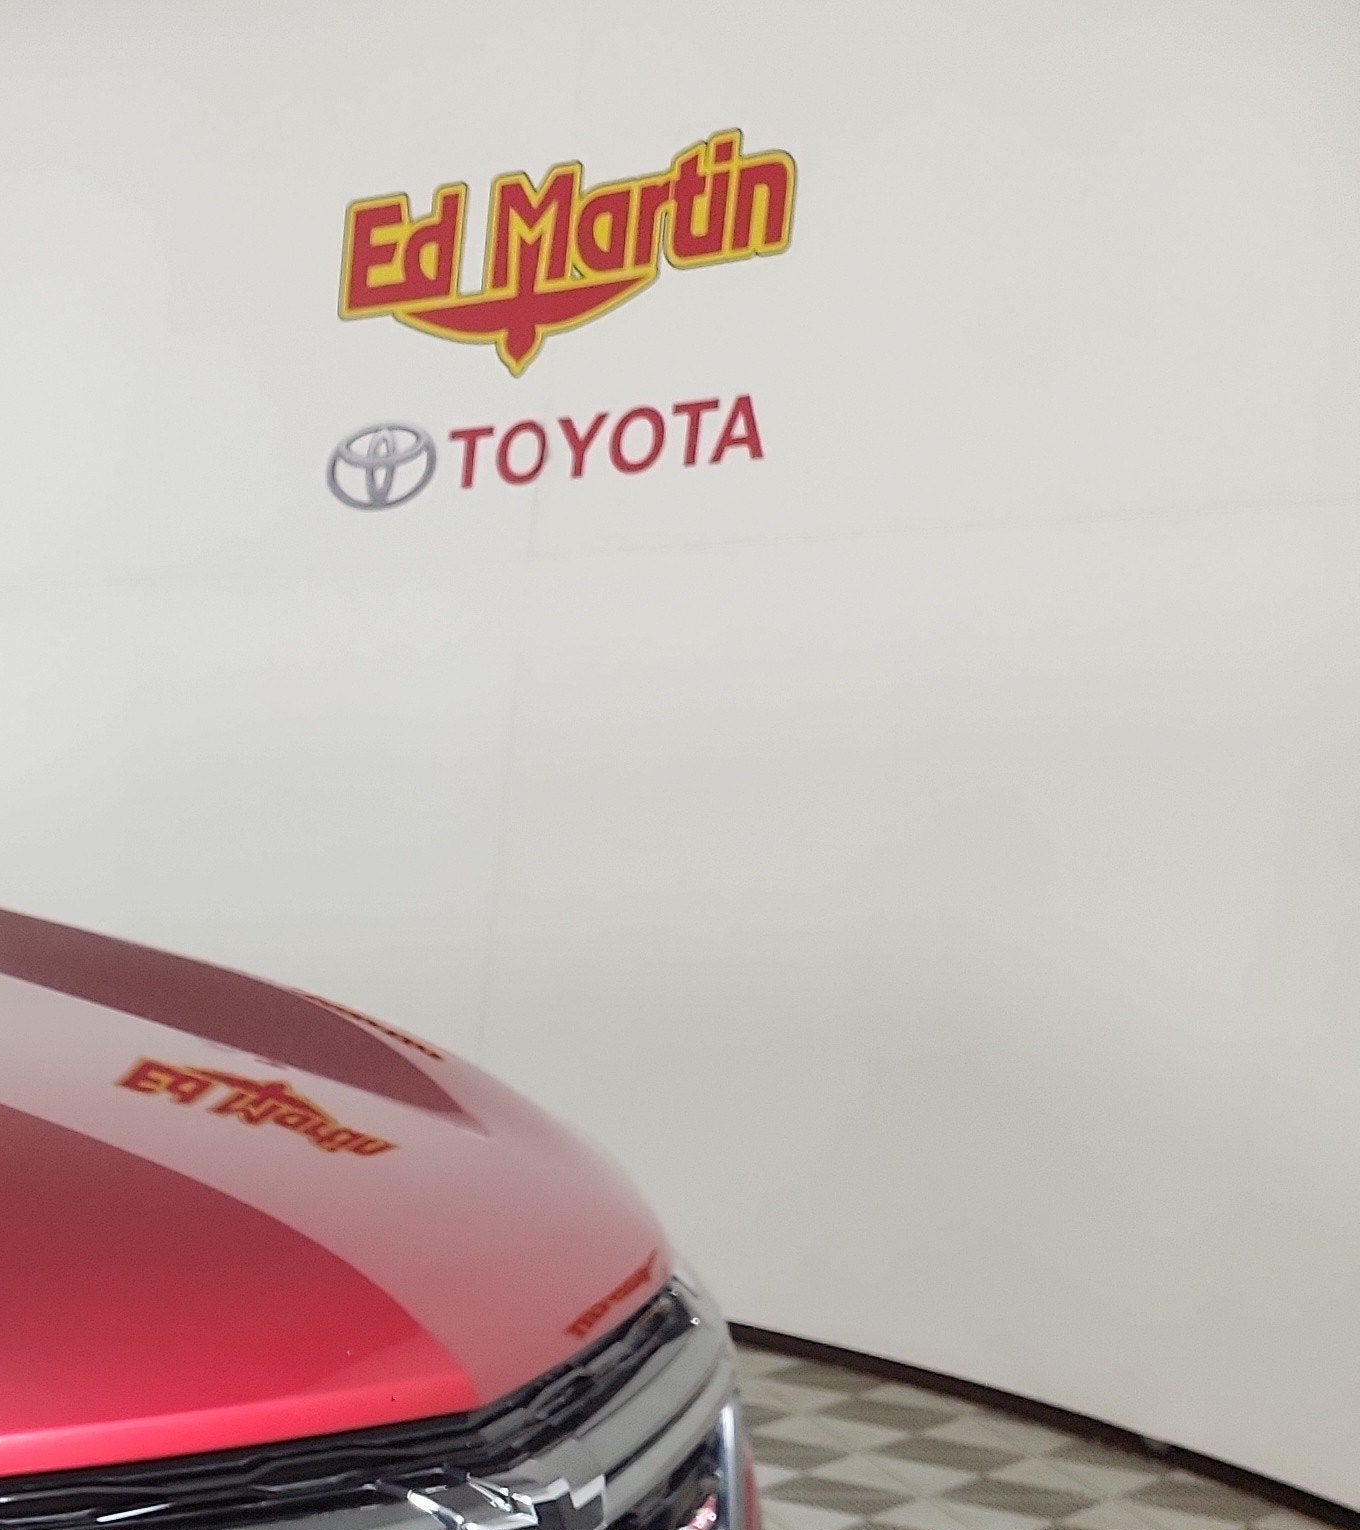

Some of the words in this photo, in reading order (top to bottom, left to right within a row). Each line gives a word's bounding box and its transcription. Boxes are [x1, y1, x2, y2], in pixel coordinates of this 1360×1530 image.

[339, 180, 468, 320] Ed
[485, 127, 796, 290] Martin
[448, 394, 764, 489] TOYOTA
